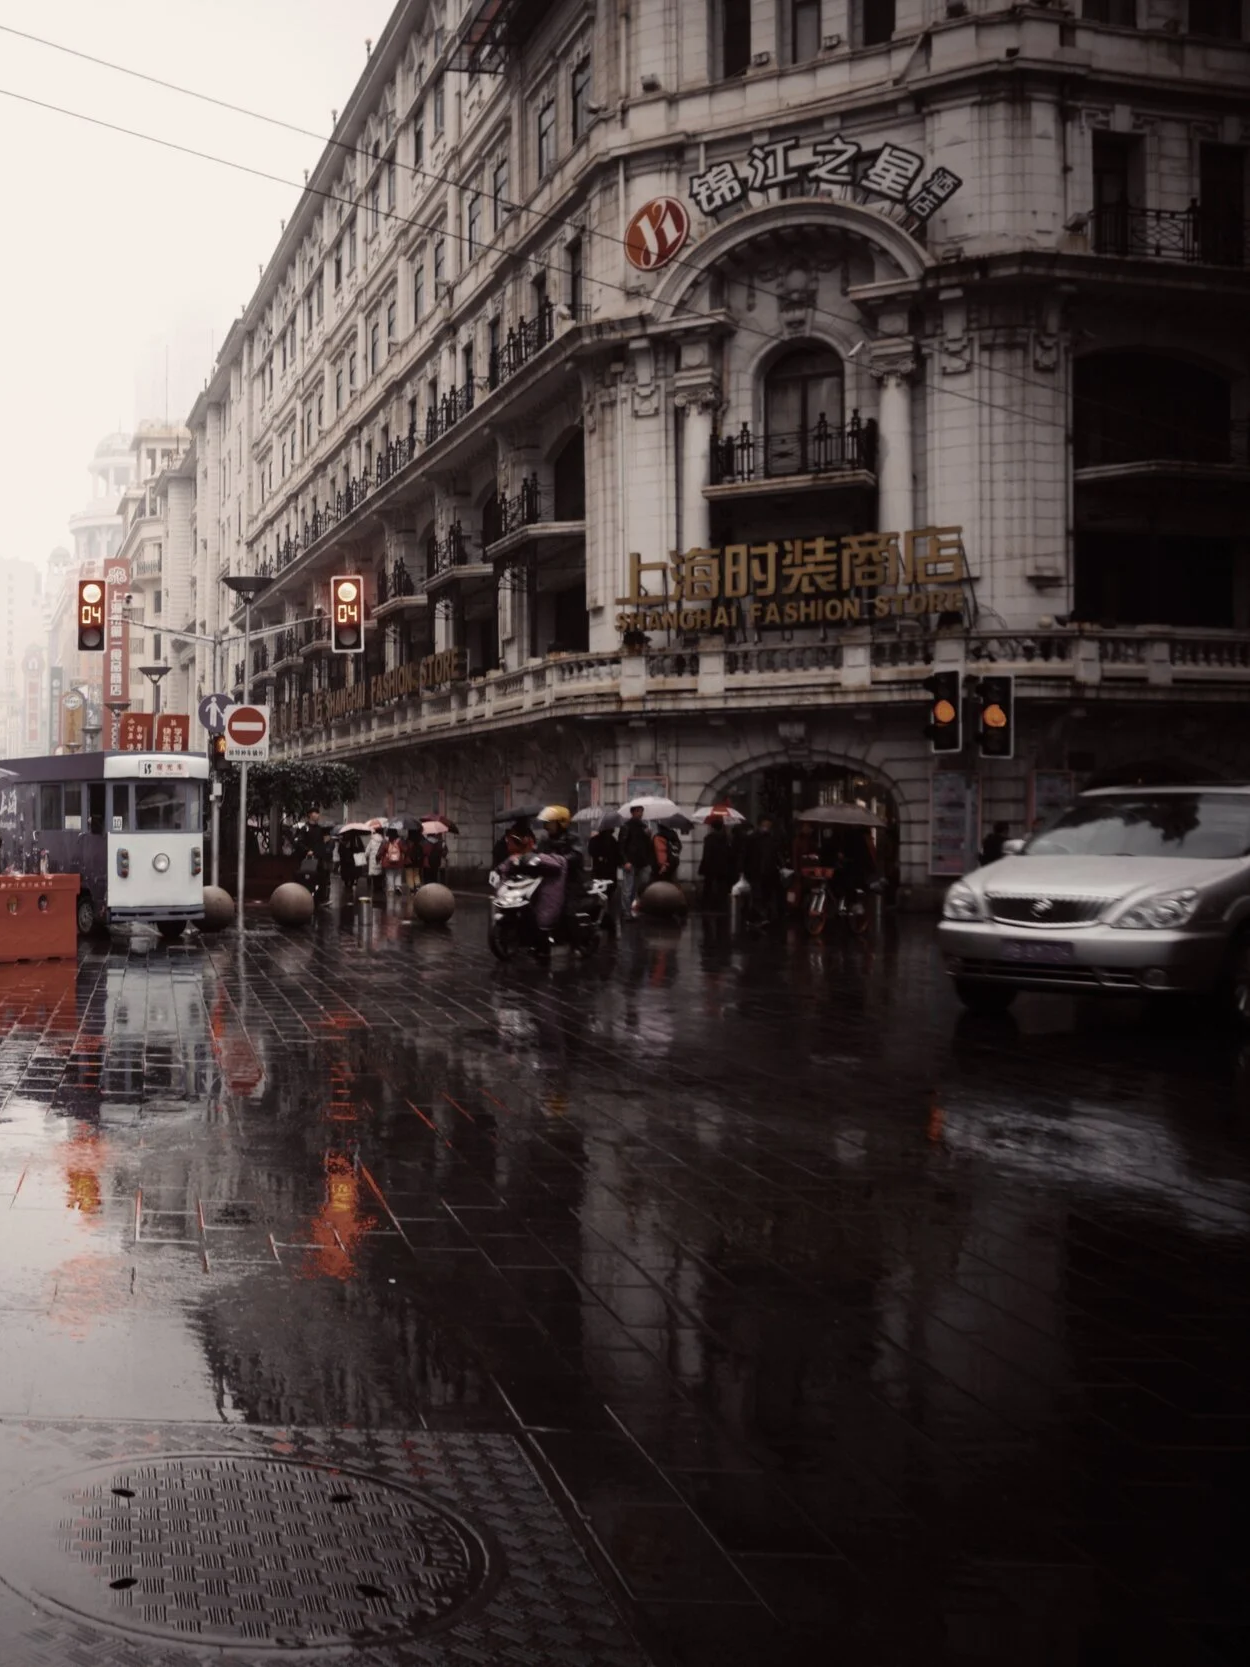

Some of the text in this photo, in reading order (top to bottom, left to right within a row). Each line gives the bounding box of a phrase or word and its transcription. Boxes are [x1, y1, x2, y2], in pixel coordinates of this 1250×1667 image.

[690, 135, 961, 220] 锦江之星 酒店
[615, 526, 963, 606] 上海时装商店
[82, 605, 101, 624] 04
[338, 604, 357, 623] 04
[615, 588, 964, 633] SHANGHAI FASHION STORE
[371, 662, 416, 703] FASHION
[420, 646, 460, 685] STORE
